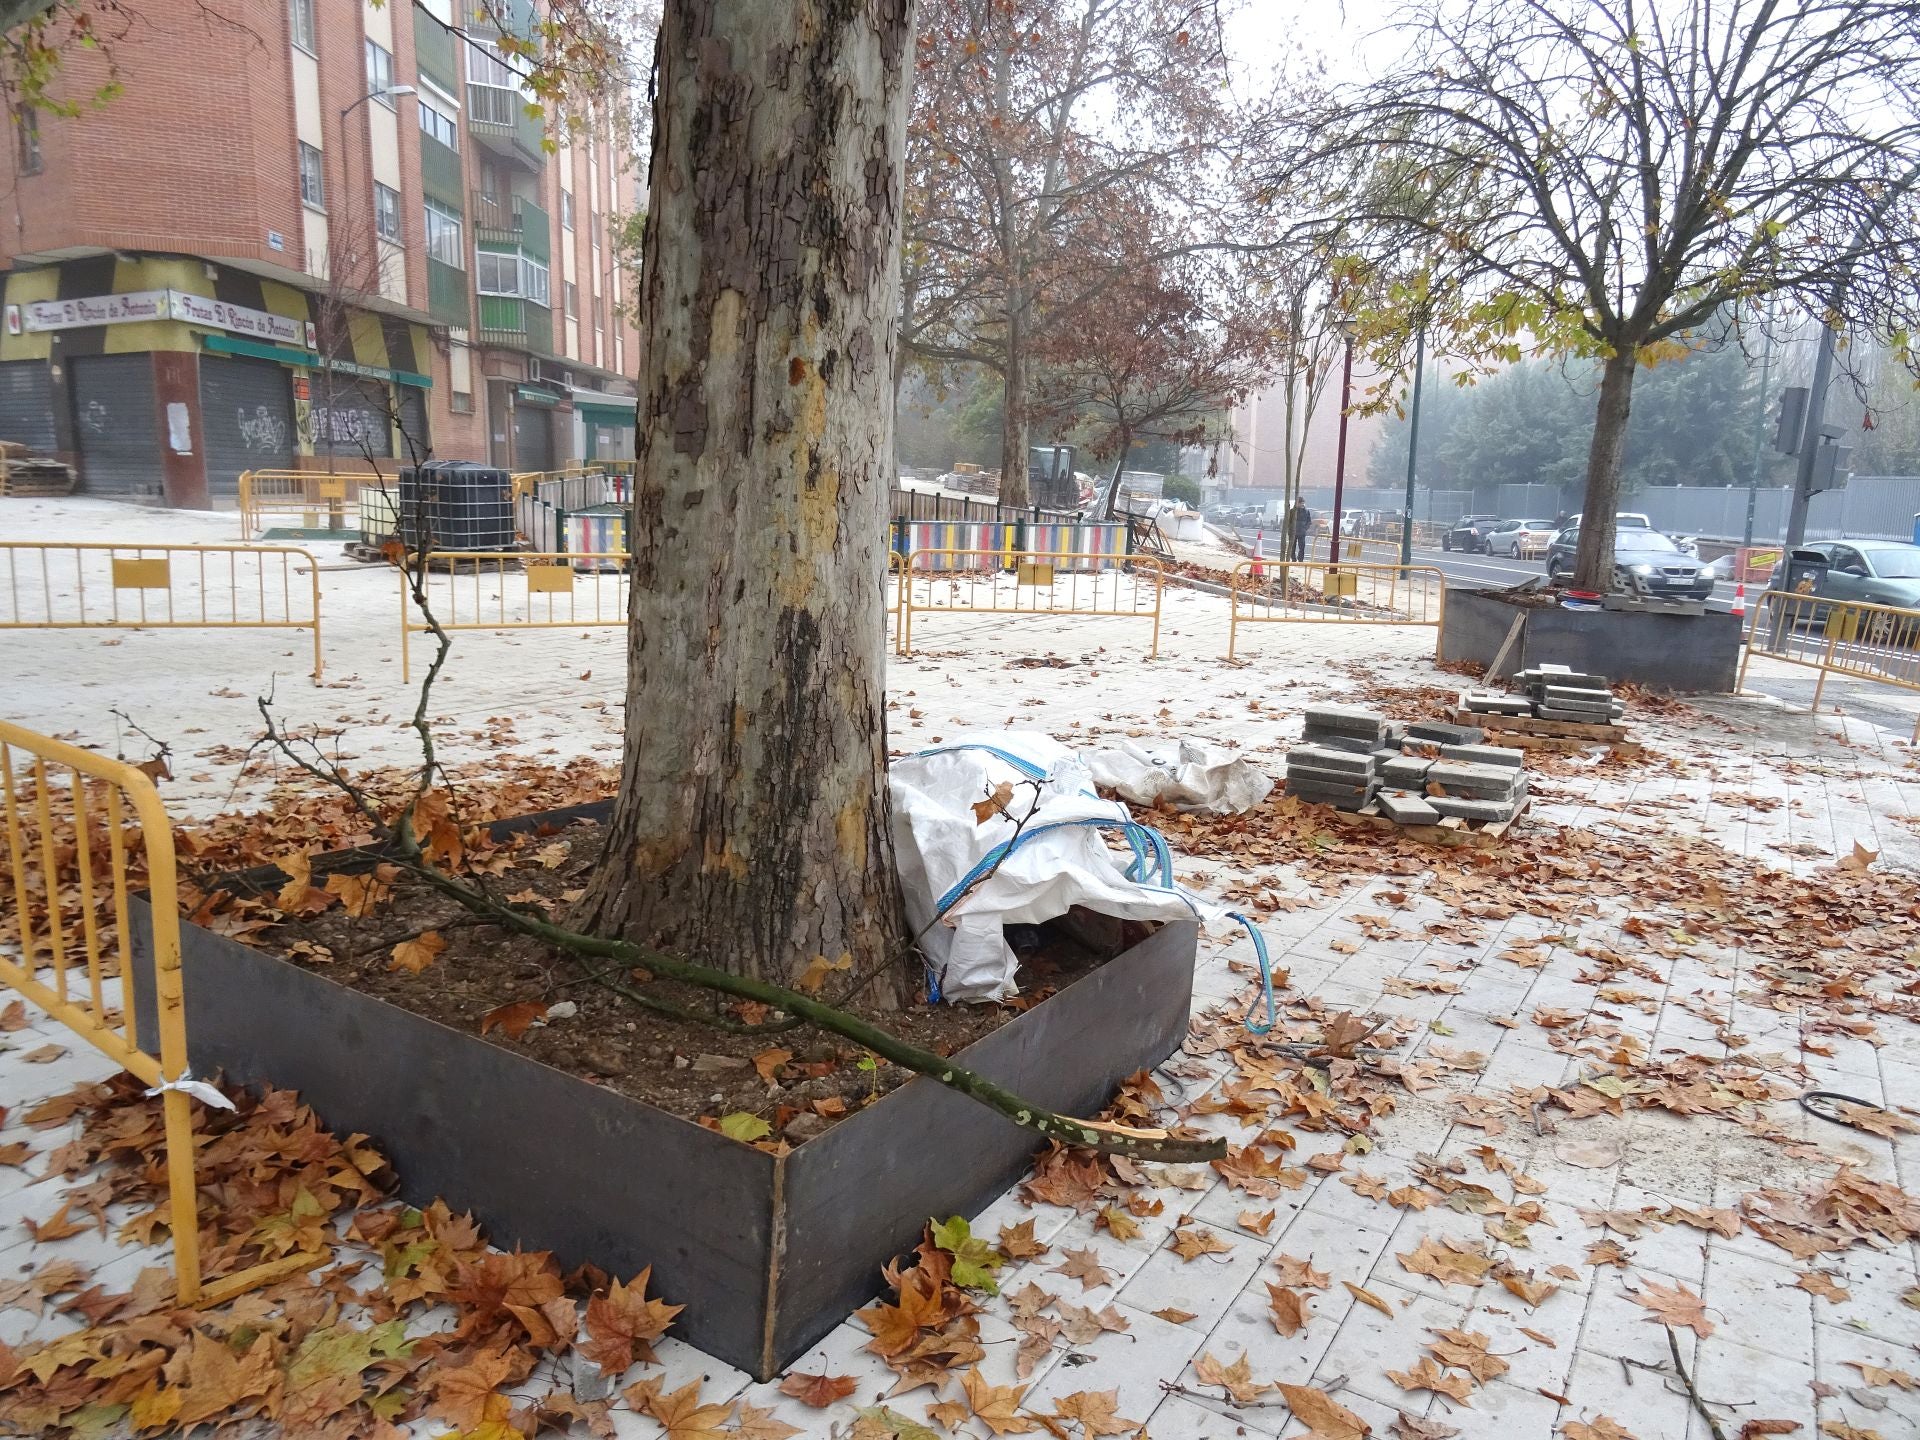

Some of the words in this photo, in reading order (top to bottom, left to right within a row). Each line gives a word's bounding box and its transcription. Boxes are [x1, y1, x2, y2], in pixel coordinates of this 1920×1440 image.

[183, 297, 212, 320] Frutas
[257, 320, 265, 332] de
[267, 317, 295, 338] Antonio
